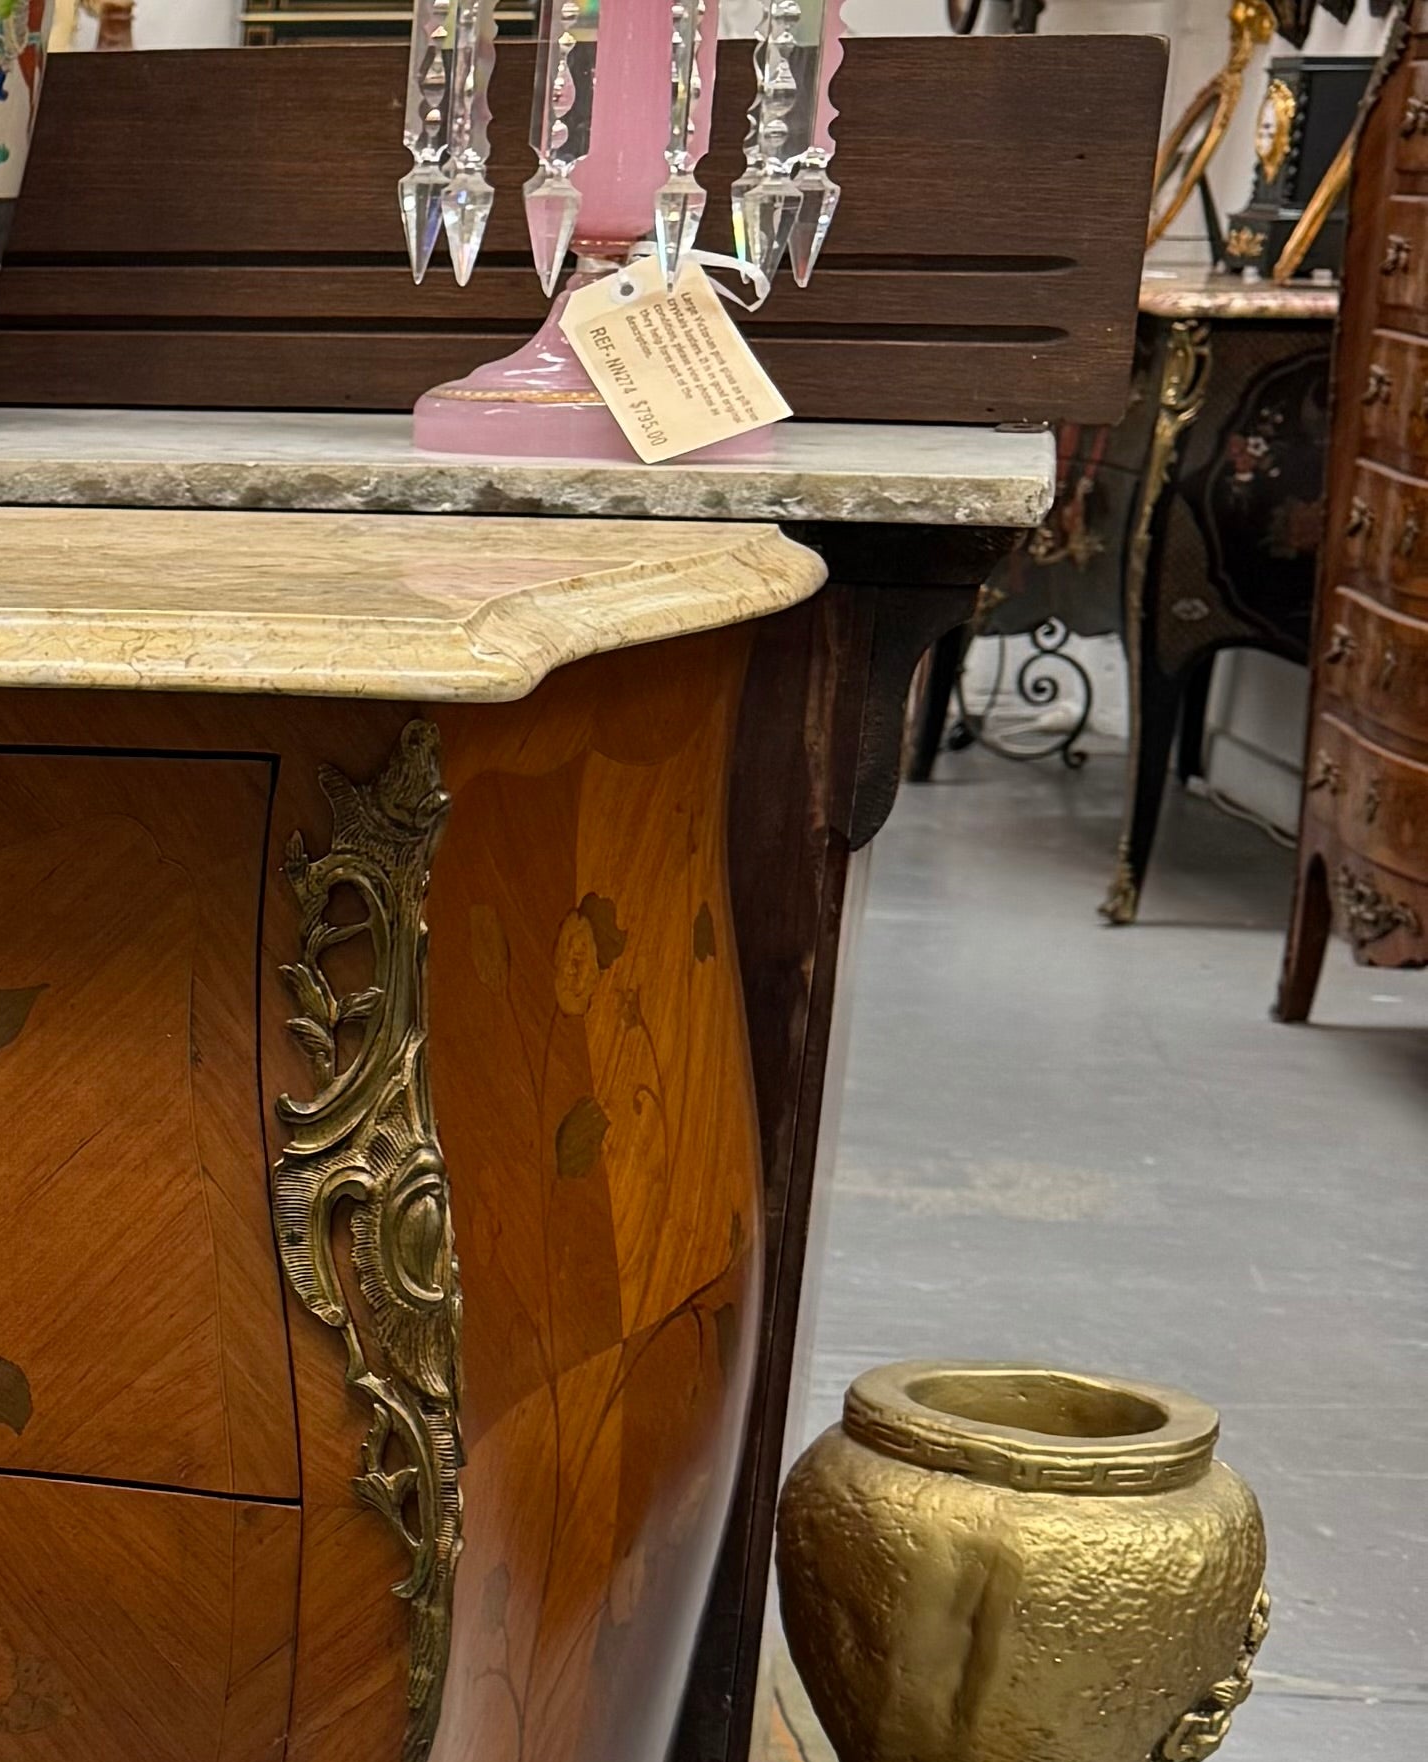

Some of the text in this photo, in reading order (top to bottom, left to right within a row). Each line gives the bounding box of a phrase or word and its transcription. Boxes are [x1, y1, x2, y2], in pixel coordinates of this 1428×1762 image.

[639, 309, 653, 328] they
[651, 328, 665, 346] help
[667, 363, 684, 379] part
[681, 385, 694, 400] the
[605, 356, 638, 395] NN274
[630, 400, 668, 447] $795.00
